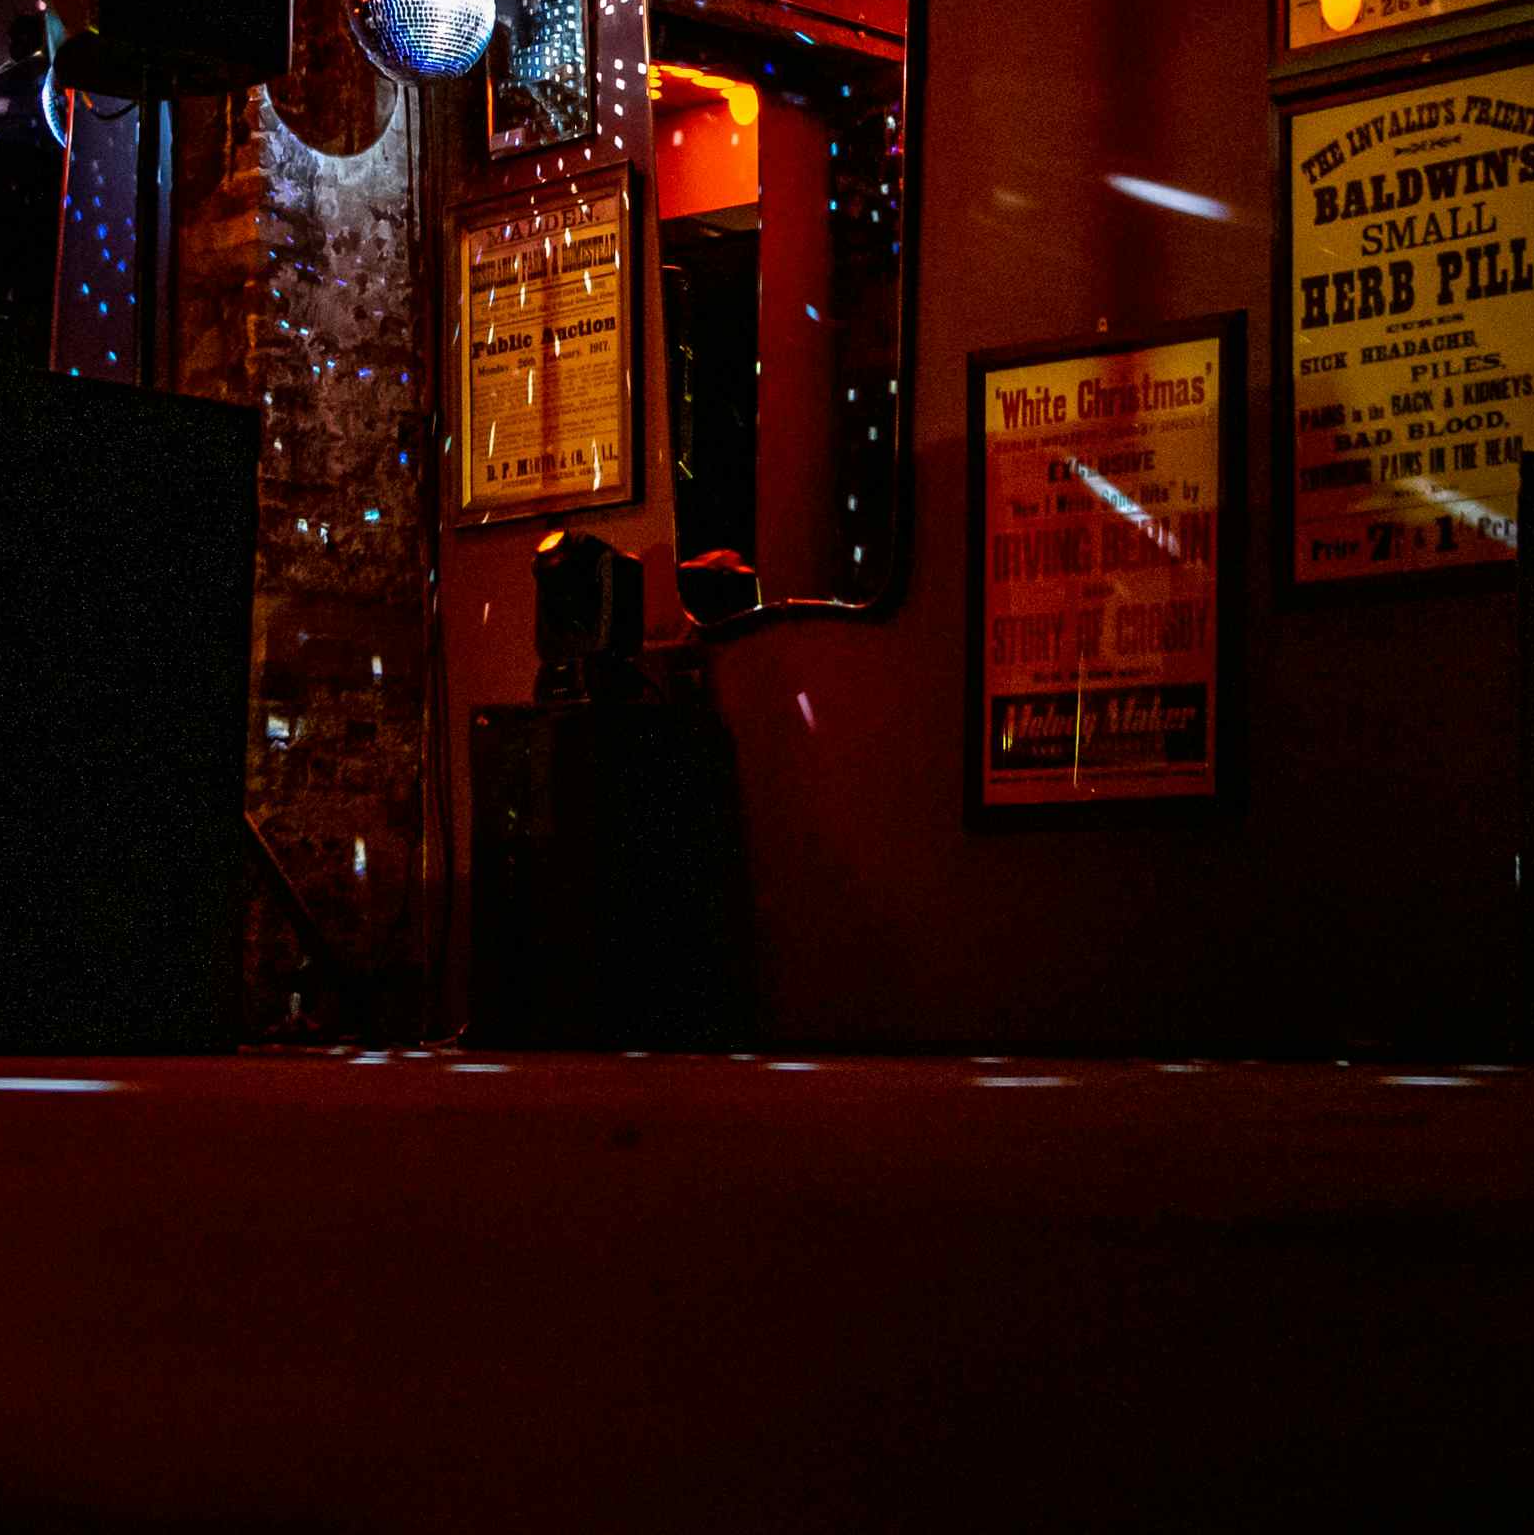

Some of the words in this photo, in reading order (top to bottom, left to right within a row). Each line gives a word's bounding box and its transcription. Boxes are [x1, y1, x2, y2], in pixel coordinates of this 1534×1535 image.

[1301, 139, 1345, 186] THE
[1345, 95, 1456, 158] INVALID'S
[1361, 201, 1498, 257] SMALL
[1301, 260, 1416, 331] HERB
[471, 332, 533, 360] Public
[541, 316, 616, 345] Auction
[1299, 350, 1349, 377] SICK
[1351, 407, 1363, 423] in
[1367, 401, 1386, 421] the
[1390, 389, 1434, 417] BACK
[1443, 386, 1455, 409] &
[1334, 427, 1393, 453] BAD
[1429, 446, 1446, 474] IN
[1452, 441, 1478, 471] THE
